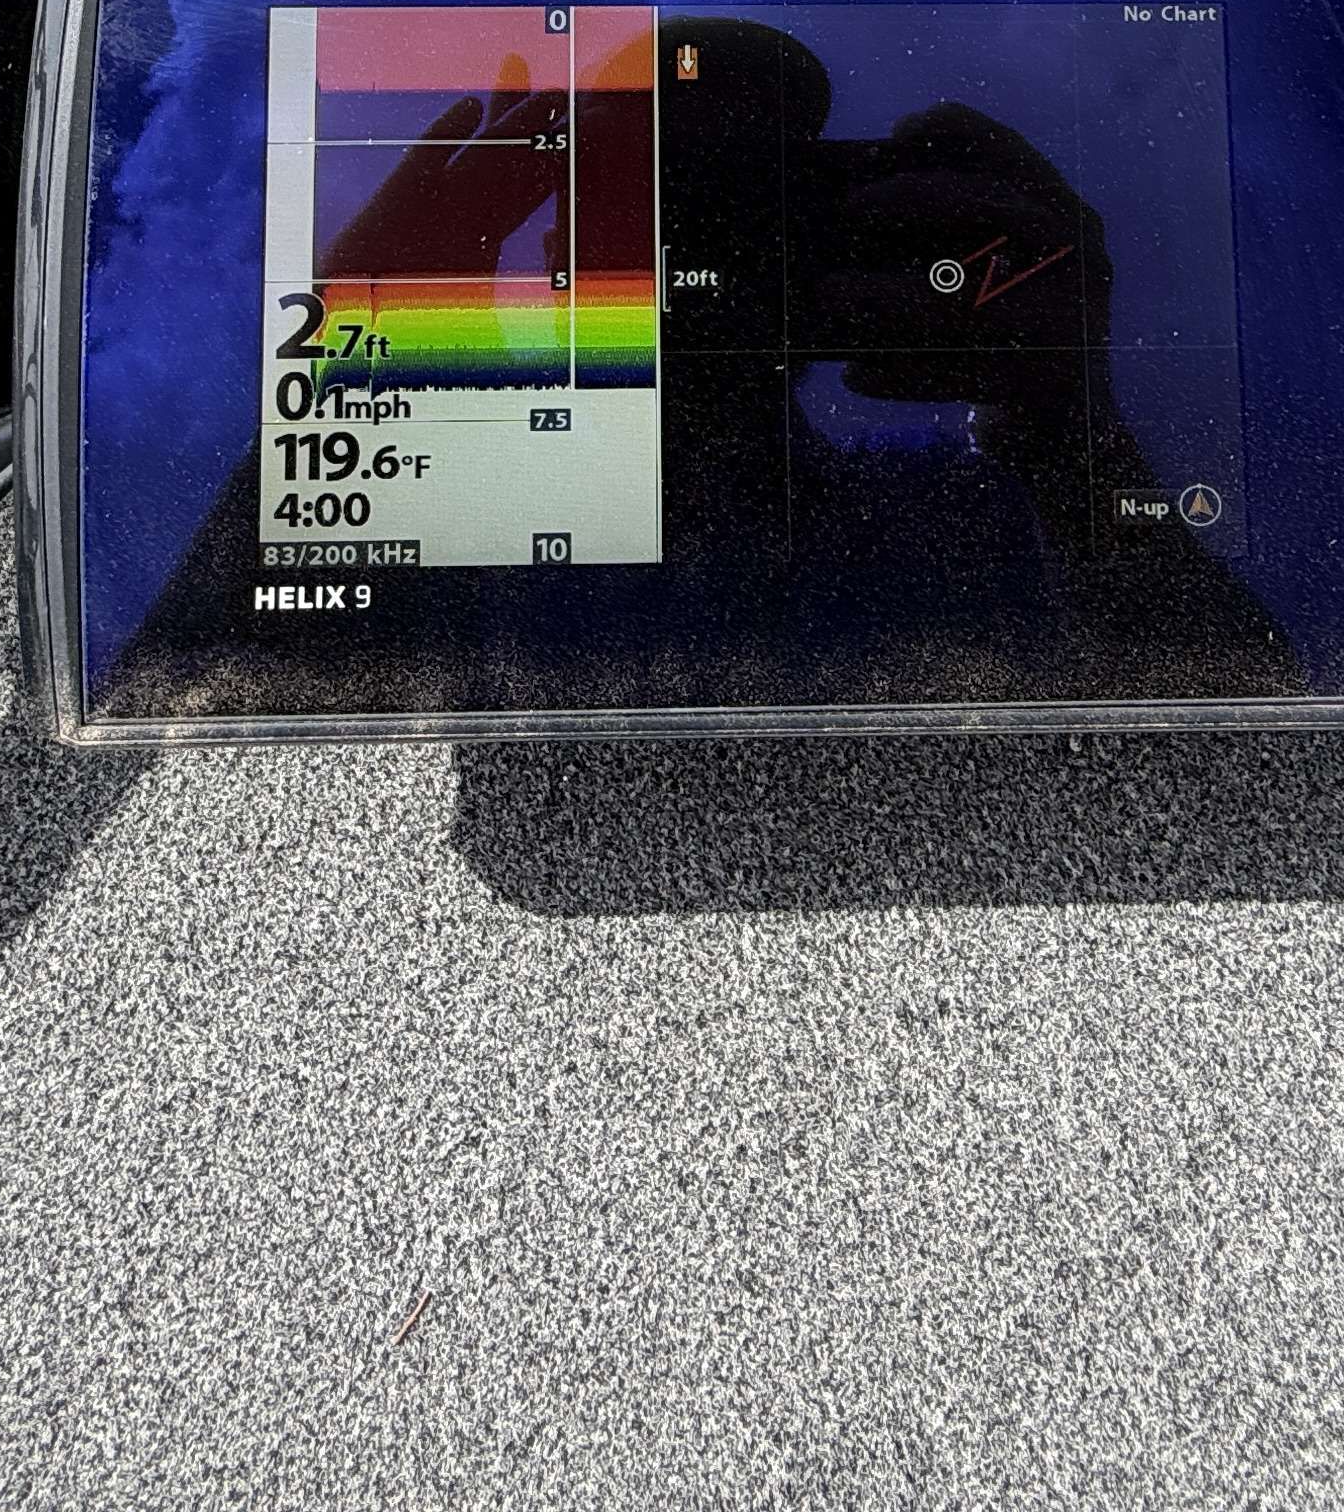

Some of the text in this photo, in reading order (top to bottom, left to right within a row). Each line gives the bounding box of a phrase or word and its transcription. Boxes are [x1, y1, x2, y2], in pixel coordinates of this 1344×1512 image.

[549, 8, 567, 31] 0
[1123, 5, 1217, 22] No Chart
[535, 134, 567, 150] 2.5
[555, 272, 567, 288] 5
[673, 269, 718, 287] 20ft
[534, 412, 568, 429] 7.5
[273, 492, 371, 528] 4:00
[1120, 498, 1169, 519] N-up
[263, 543, 417, 568] 83/200 kHz
[536, 538, 568, 560] 10
[255, 585, 372, 610] HELIX 9
